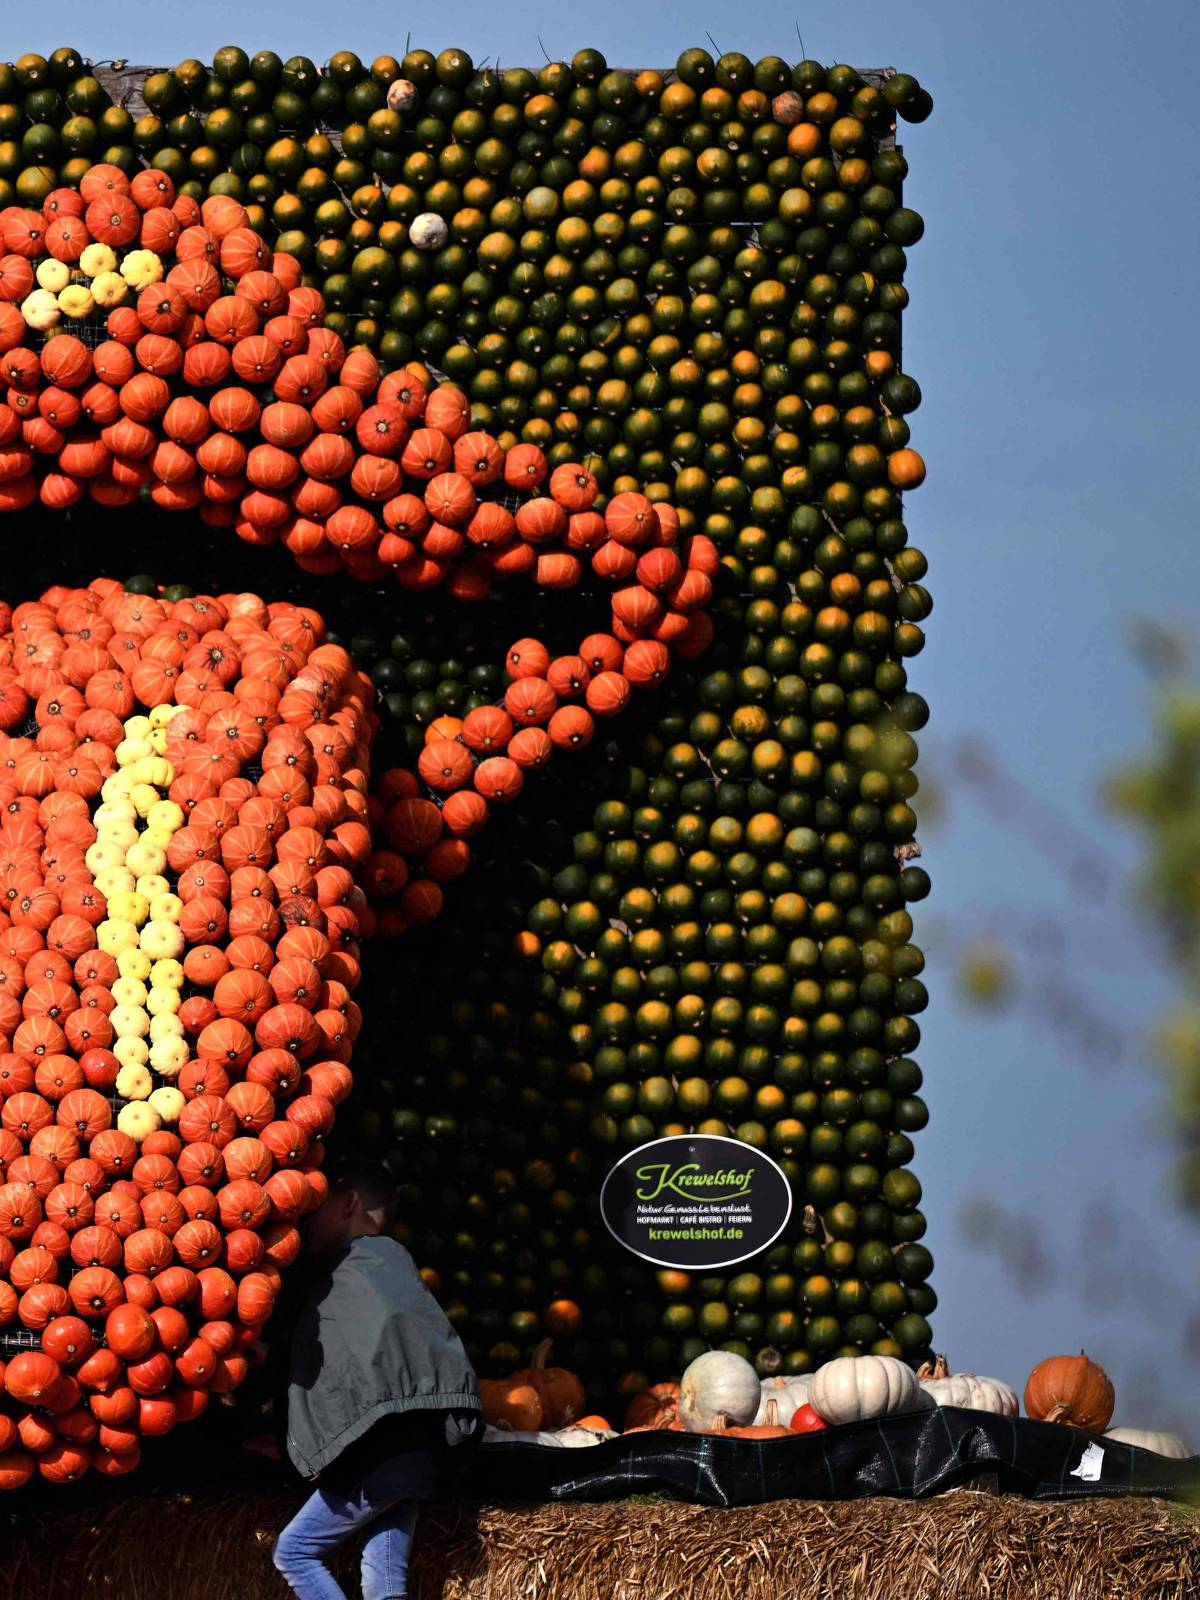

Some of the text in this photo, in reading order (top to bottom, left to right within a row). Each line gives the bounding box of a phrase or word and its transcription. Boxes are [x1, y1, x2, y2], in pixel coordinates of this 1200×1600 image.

[636, 1163, 754, 1202] Krewelshof
[636, 1214, 752, 1224] HOFMARKT CAFÉ BISTRO FEIERN
[648, 1227, 744, 1240] krewelshof.de
